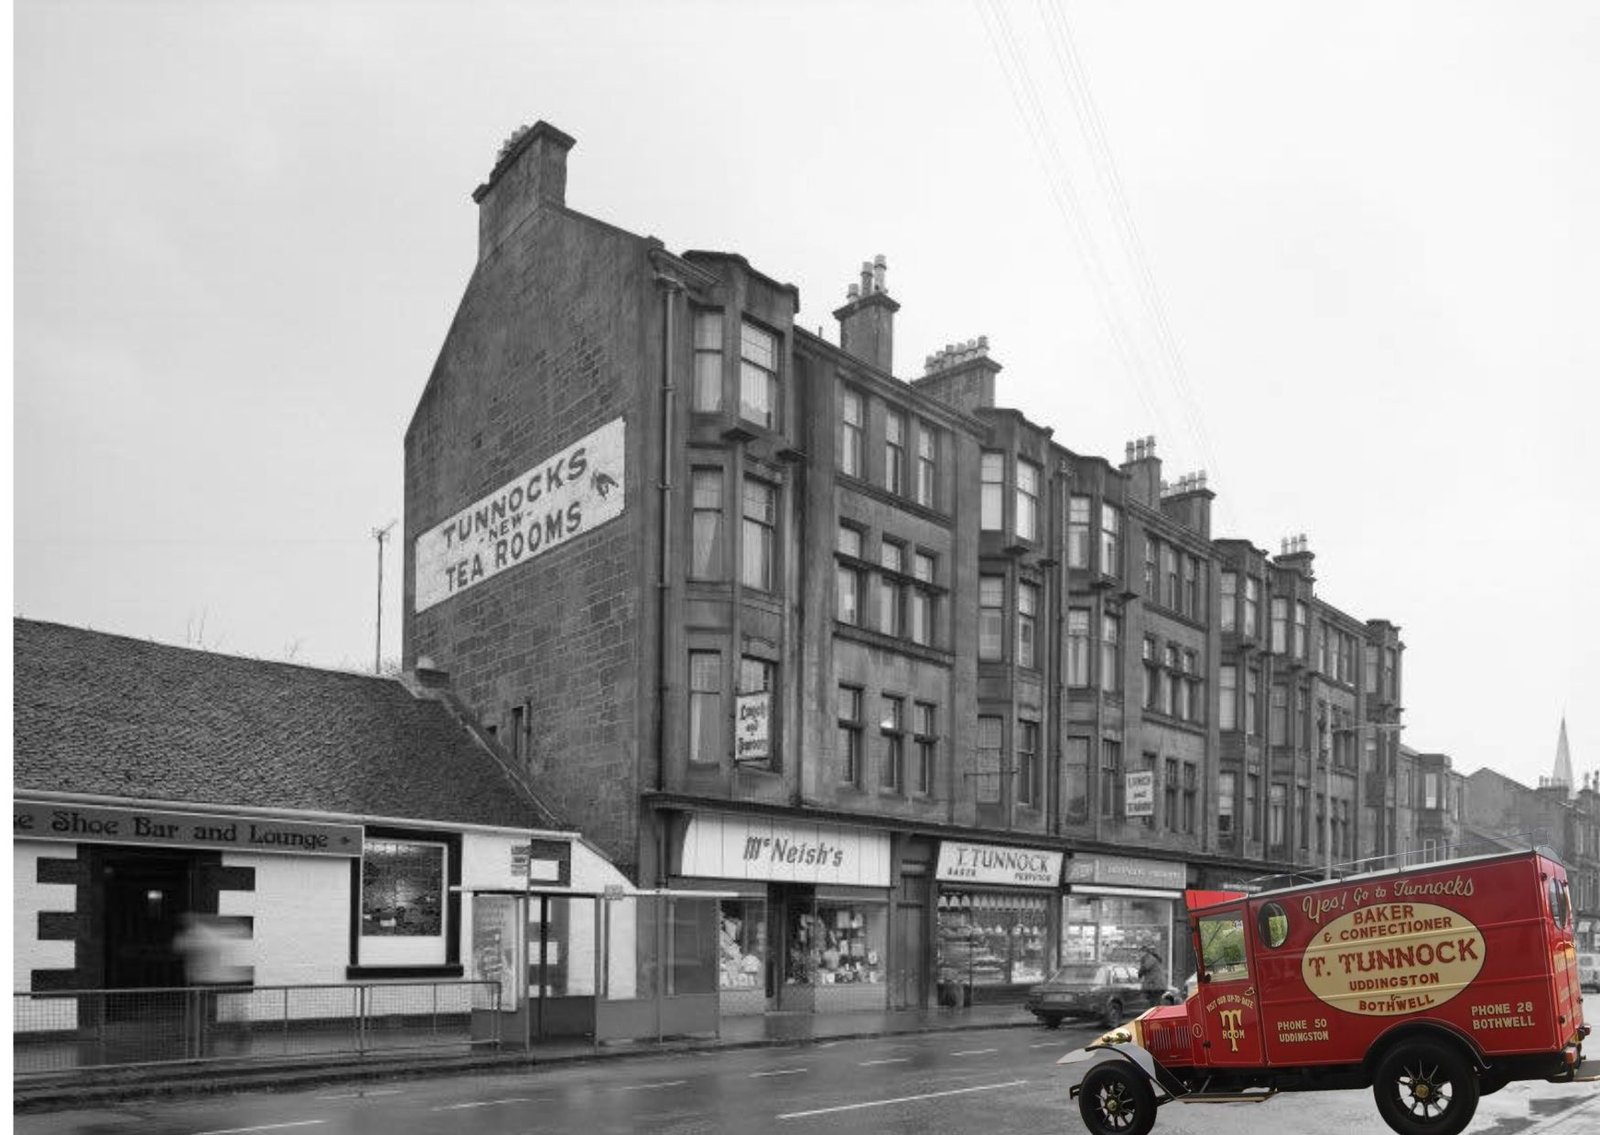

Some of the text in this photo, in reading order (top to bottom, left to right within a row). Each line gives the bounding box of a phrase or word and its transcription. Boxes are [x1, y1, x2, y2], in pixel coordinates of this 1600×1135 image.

[442, 447, 588, 549] TUNNOCKS
[445, 501, 582, 592] TEA ROOMS
[51, 811, 119, 834] Shoe
[133, 816, 179, 838] Bar
[193, 823, 236, 842] and
[249, 824, 328, 850] Lounge
[1302, 875, 1475, 924] Yes! Go to Tunnocks
[1353, 904, 1415, 926] BAKER
[1324, 916, 1453, 943] & CONFECTIONER
[1308, 937, 1479, 978] T. TUNNOCK
[1349, 972, 1440, 992] UDDINGSTON
[1359, 994, 1435, 1013] BOTHWELL
[1471, 1001, 1533, 1016] PHONE 28
[1277, 1018, 1327, 1031] PHONE 50
[1472, 1016, 1536, 1030] BOTHWELL
[1222, 1029, 1245, 1040] ROOM
[1279, 1031, 1329, 1043] UDDINGSTON
